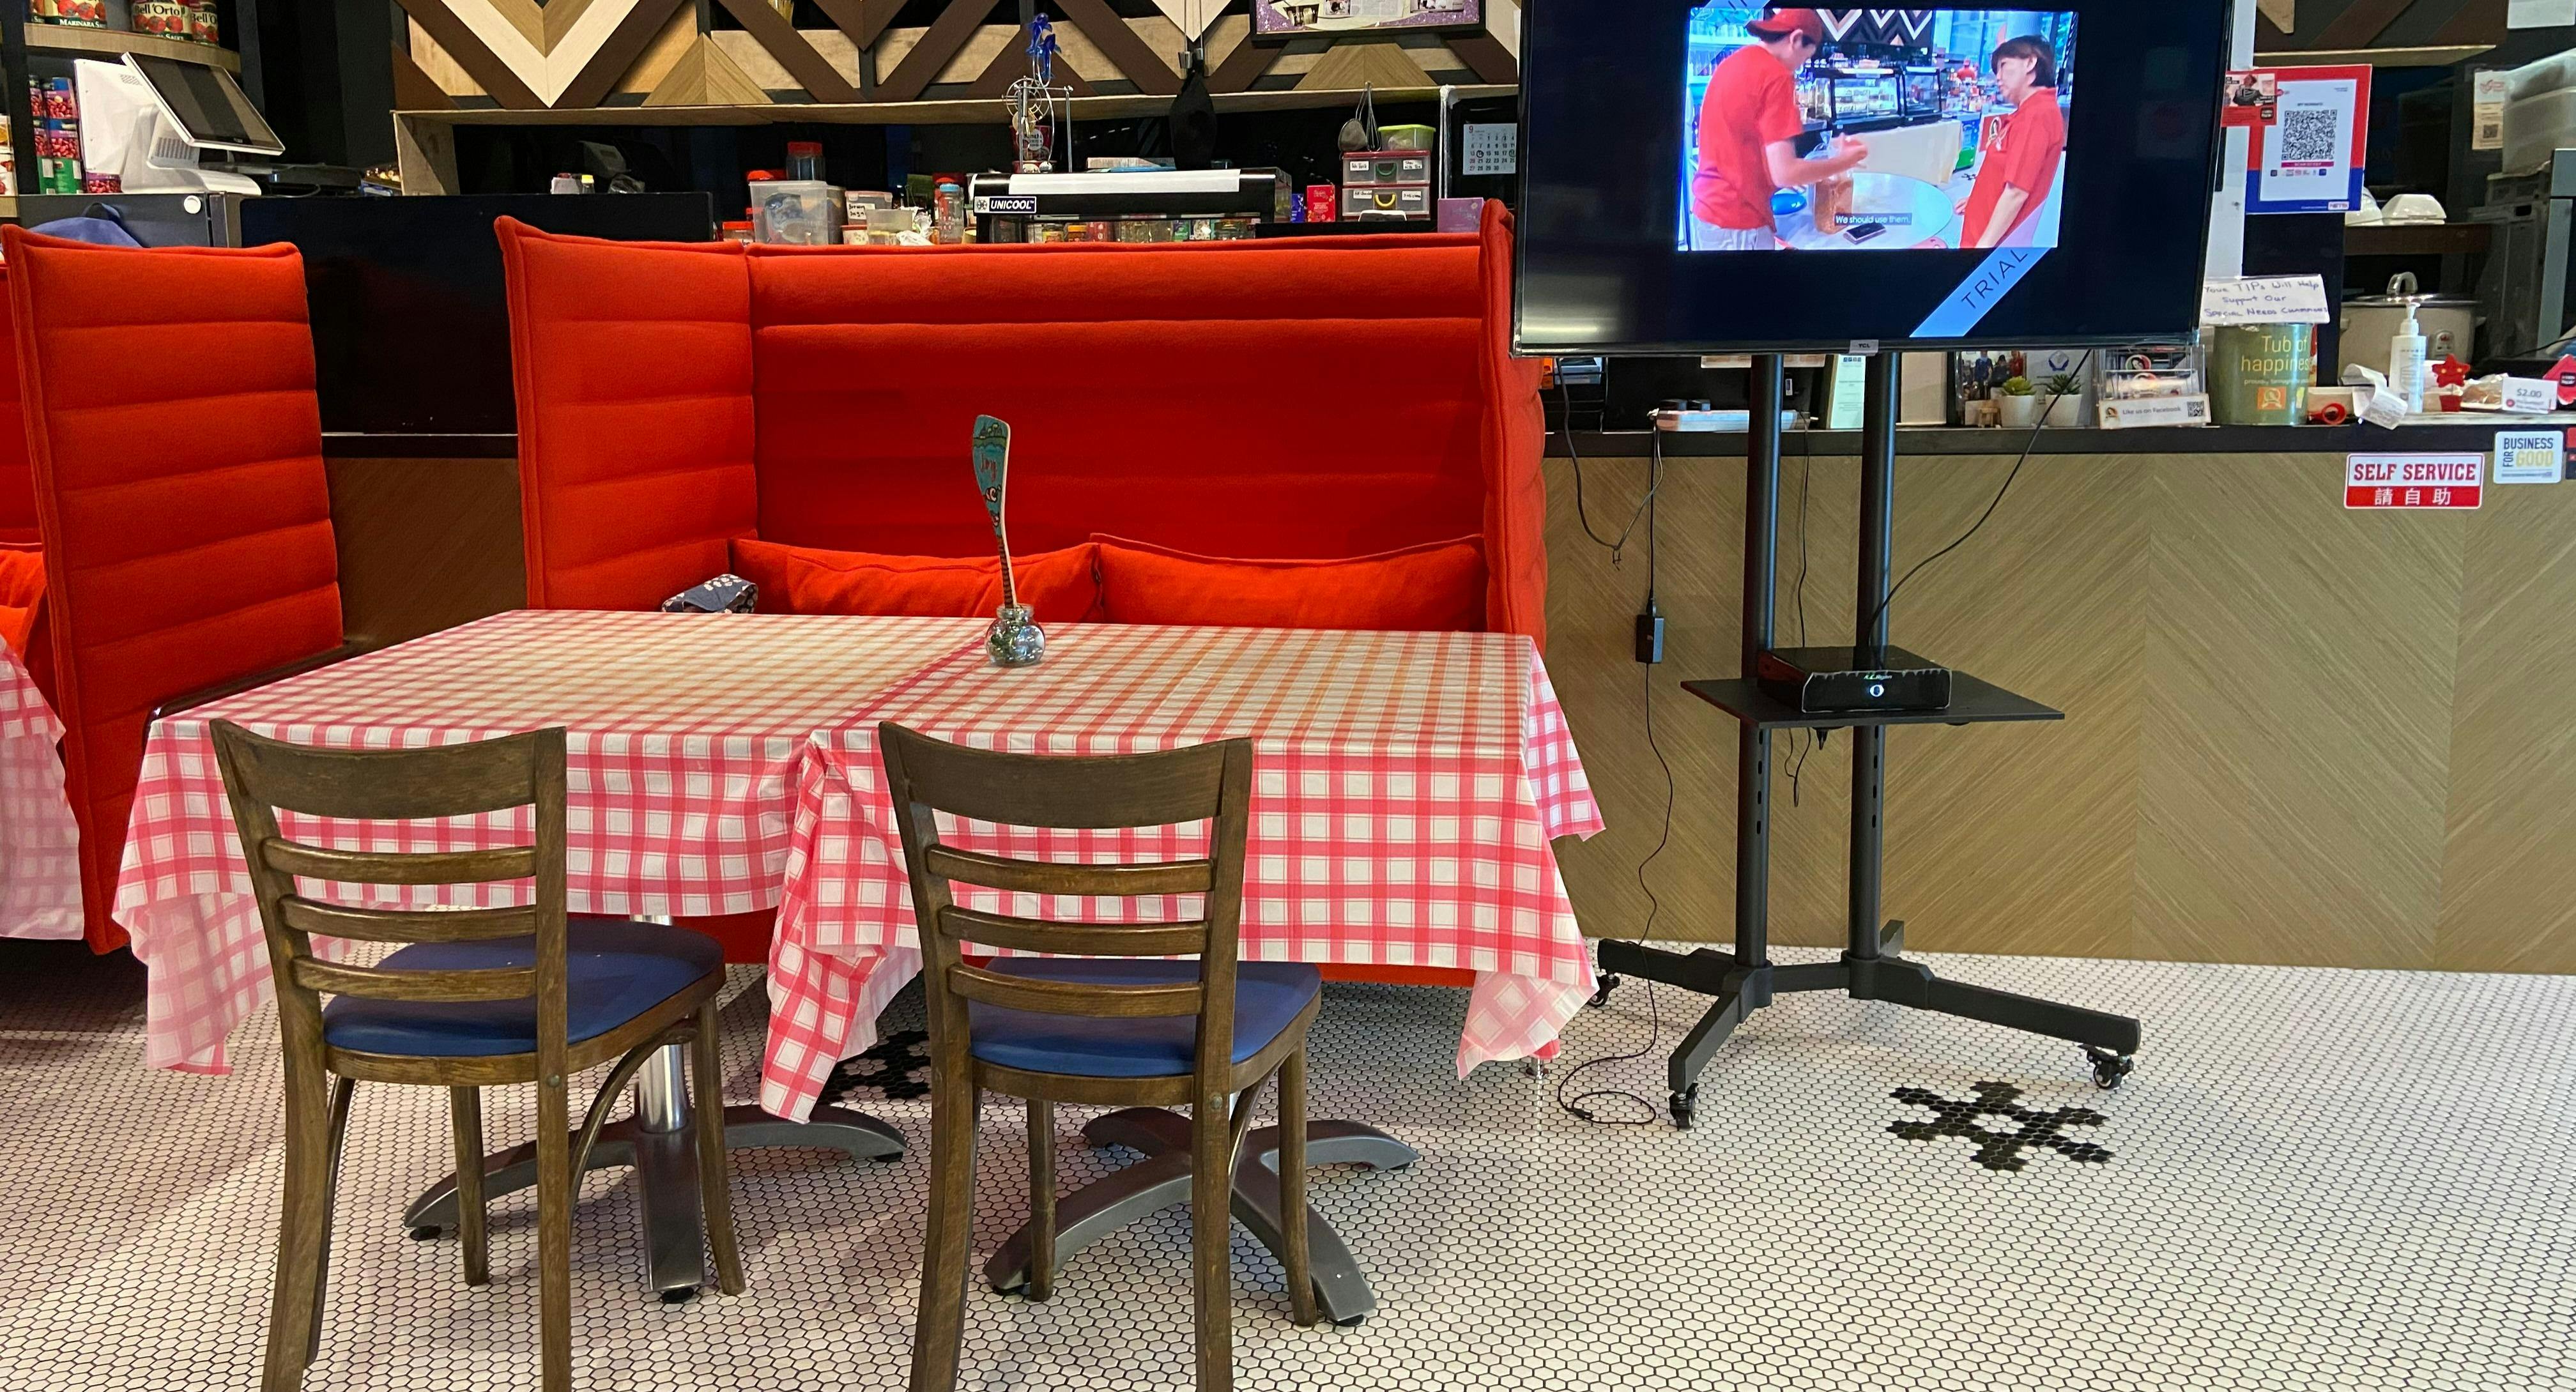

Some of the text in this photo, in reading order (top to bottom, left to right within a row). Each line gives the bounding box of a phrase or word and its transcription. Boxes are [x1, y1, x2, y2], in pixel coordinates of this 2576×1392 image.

[990, 200, 1032, 210] UNICOOL
[1836, 215, 1848, 224] We
[1849, 215, 1874, 224] should
[1961, 249, 2028, 309] TRIAL
[2262, 335, 2308, 353] Tub of
[2517, 388, 2542, 398] $2.00
[2504, 438, 2554, 450] BUSINESS
[2503, 450, 2554, 467] FOR GOOD
[2354, 463, 2477, 481] SELF SERVICE
[2375, 487, 2451, 506] 請自助
